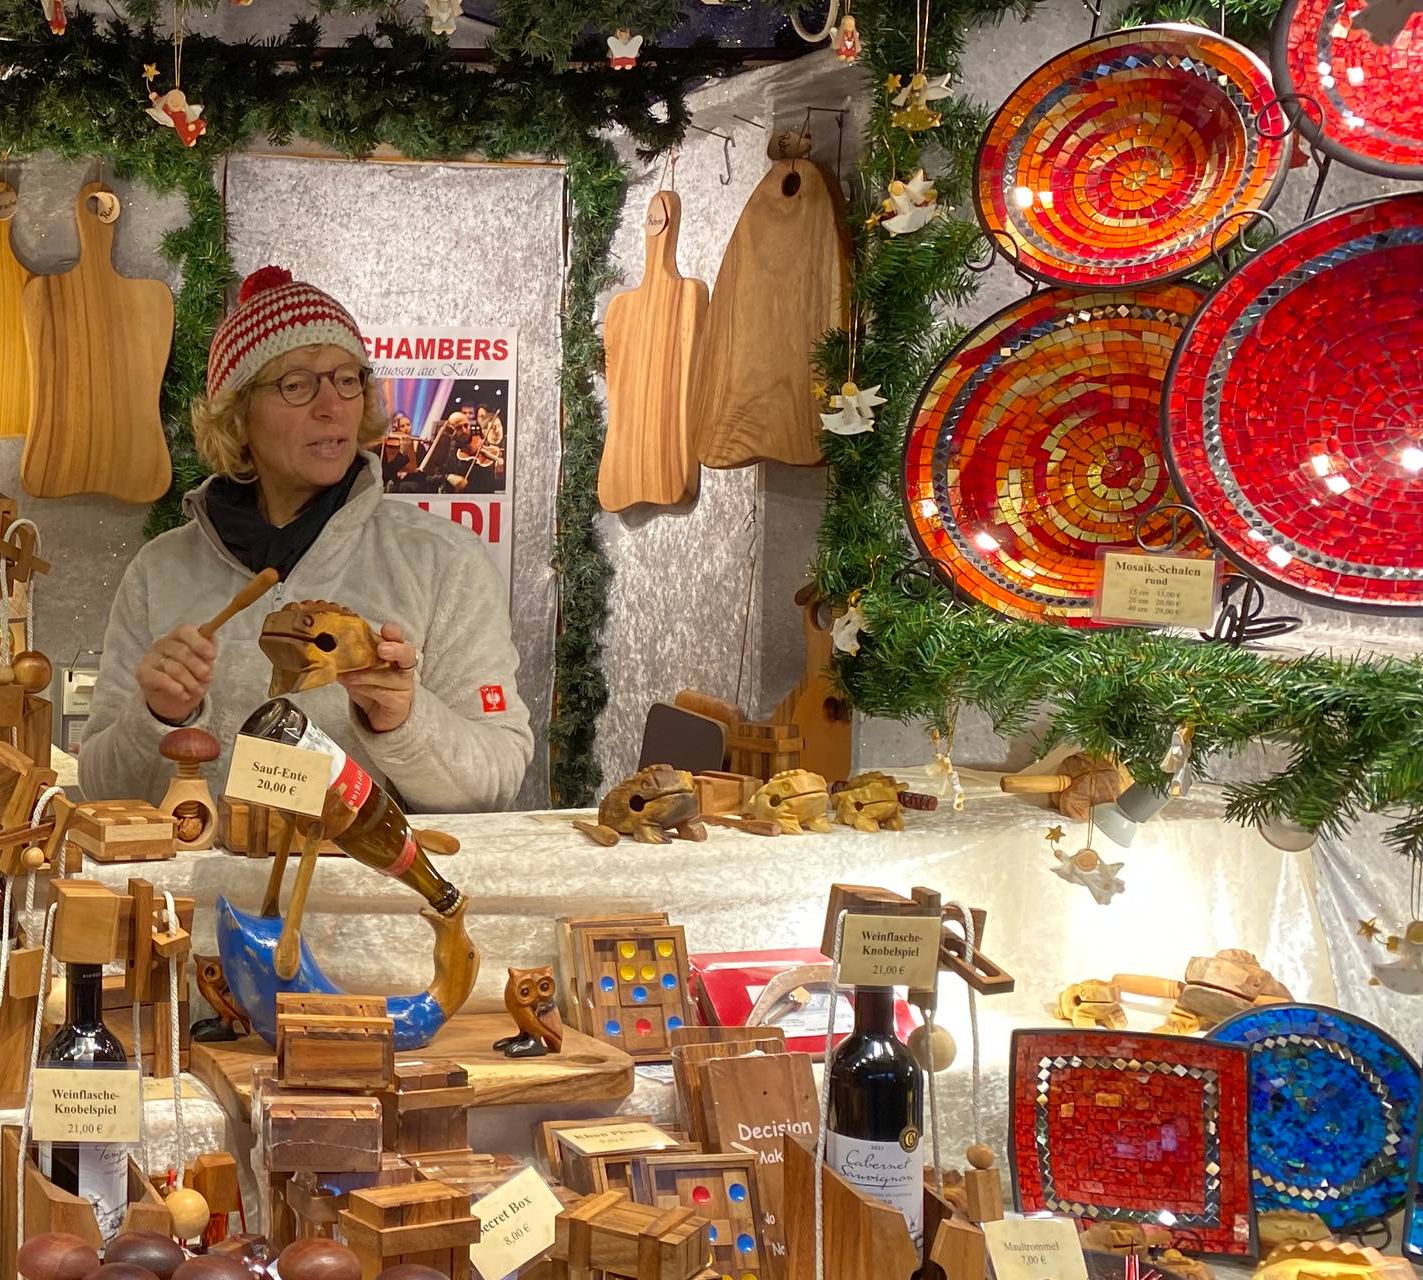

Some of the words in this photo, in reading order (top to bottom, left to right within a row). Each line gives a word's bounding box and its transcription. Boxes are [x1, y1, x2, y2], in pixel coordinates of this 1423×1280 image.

[417, 367, 437, 376] aus
[440, 362, 479, 377] Köln
[1115, 561, 1201, 577] Mosaik-Schalen
[251, 761, 308, 782] Sauf-Ente
[257, 778, 287, 794] 20,00
[289, 785, 297, 796] €
[862, 930, 924, 942] Weinflasche-
[862, 945, 919, 959] Knobelspiel
[873, 964, 897, 976] 21,00
[899, 965, 905, 975] €
[52, 1088, 120, 1100] Weinflasche-
[54, 1104, 117, 1117] Knobelspiel
[68, 1123, 95, 1134] 21,00
[97, 1124, 104, 1134] €
[737, 1119, 812, 1141] Decision
[846, 1150, 913, 1169] Cabernet
[841, 1164, 913, 1190] Sauvignon
[509, 1196, 532, 1215] Box
[503, 1227, 524, 1246] 8,00
[523, 1223, 531, 1233] €
[1004, 1240, 1059, 1251] Maultrommel
[1021, 1255, 1039, 1265] 7,00
[1040, 1255, 1047, 1264] €
